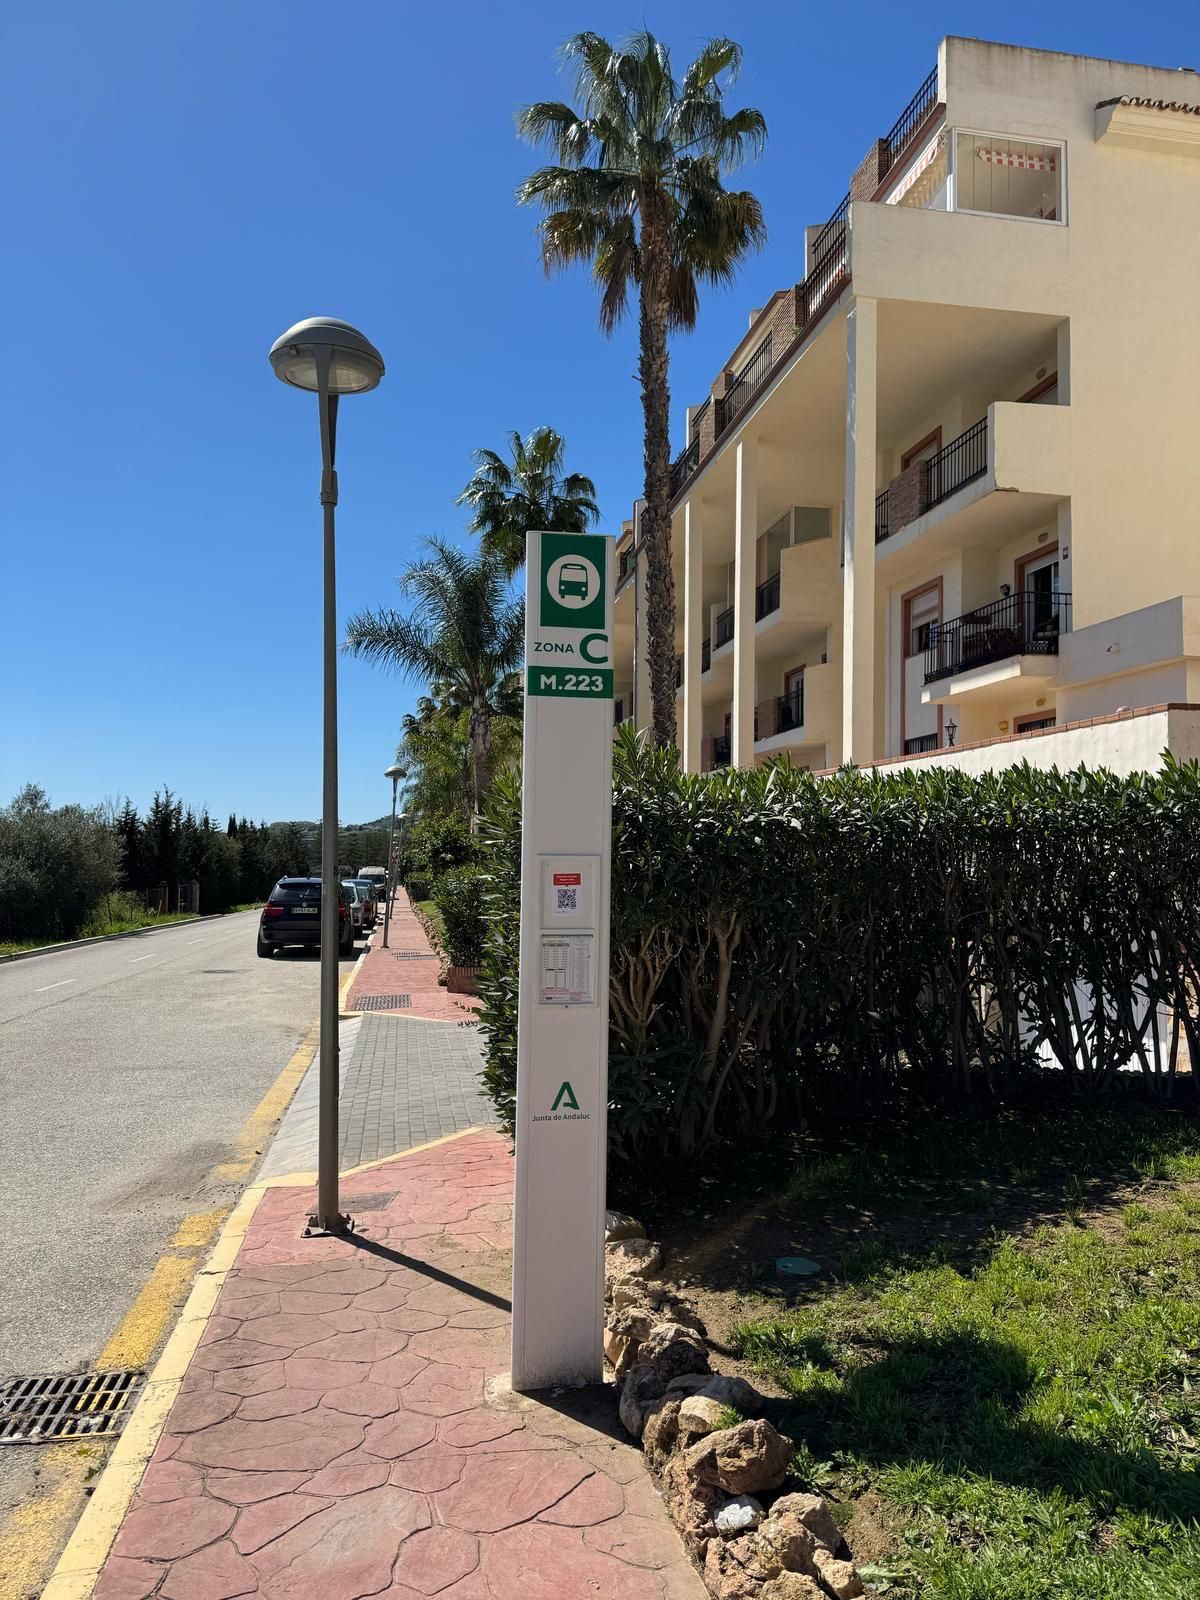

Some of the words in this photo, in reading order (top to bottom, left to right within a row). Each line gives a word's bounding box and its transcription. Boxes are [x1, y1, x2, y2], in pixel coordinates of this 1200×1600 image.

[534, 642, 574, 653] ZONA
[579, 633, 608, 664] C
[540, 674, 603, 691] M.223
